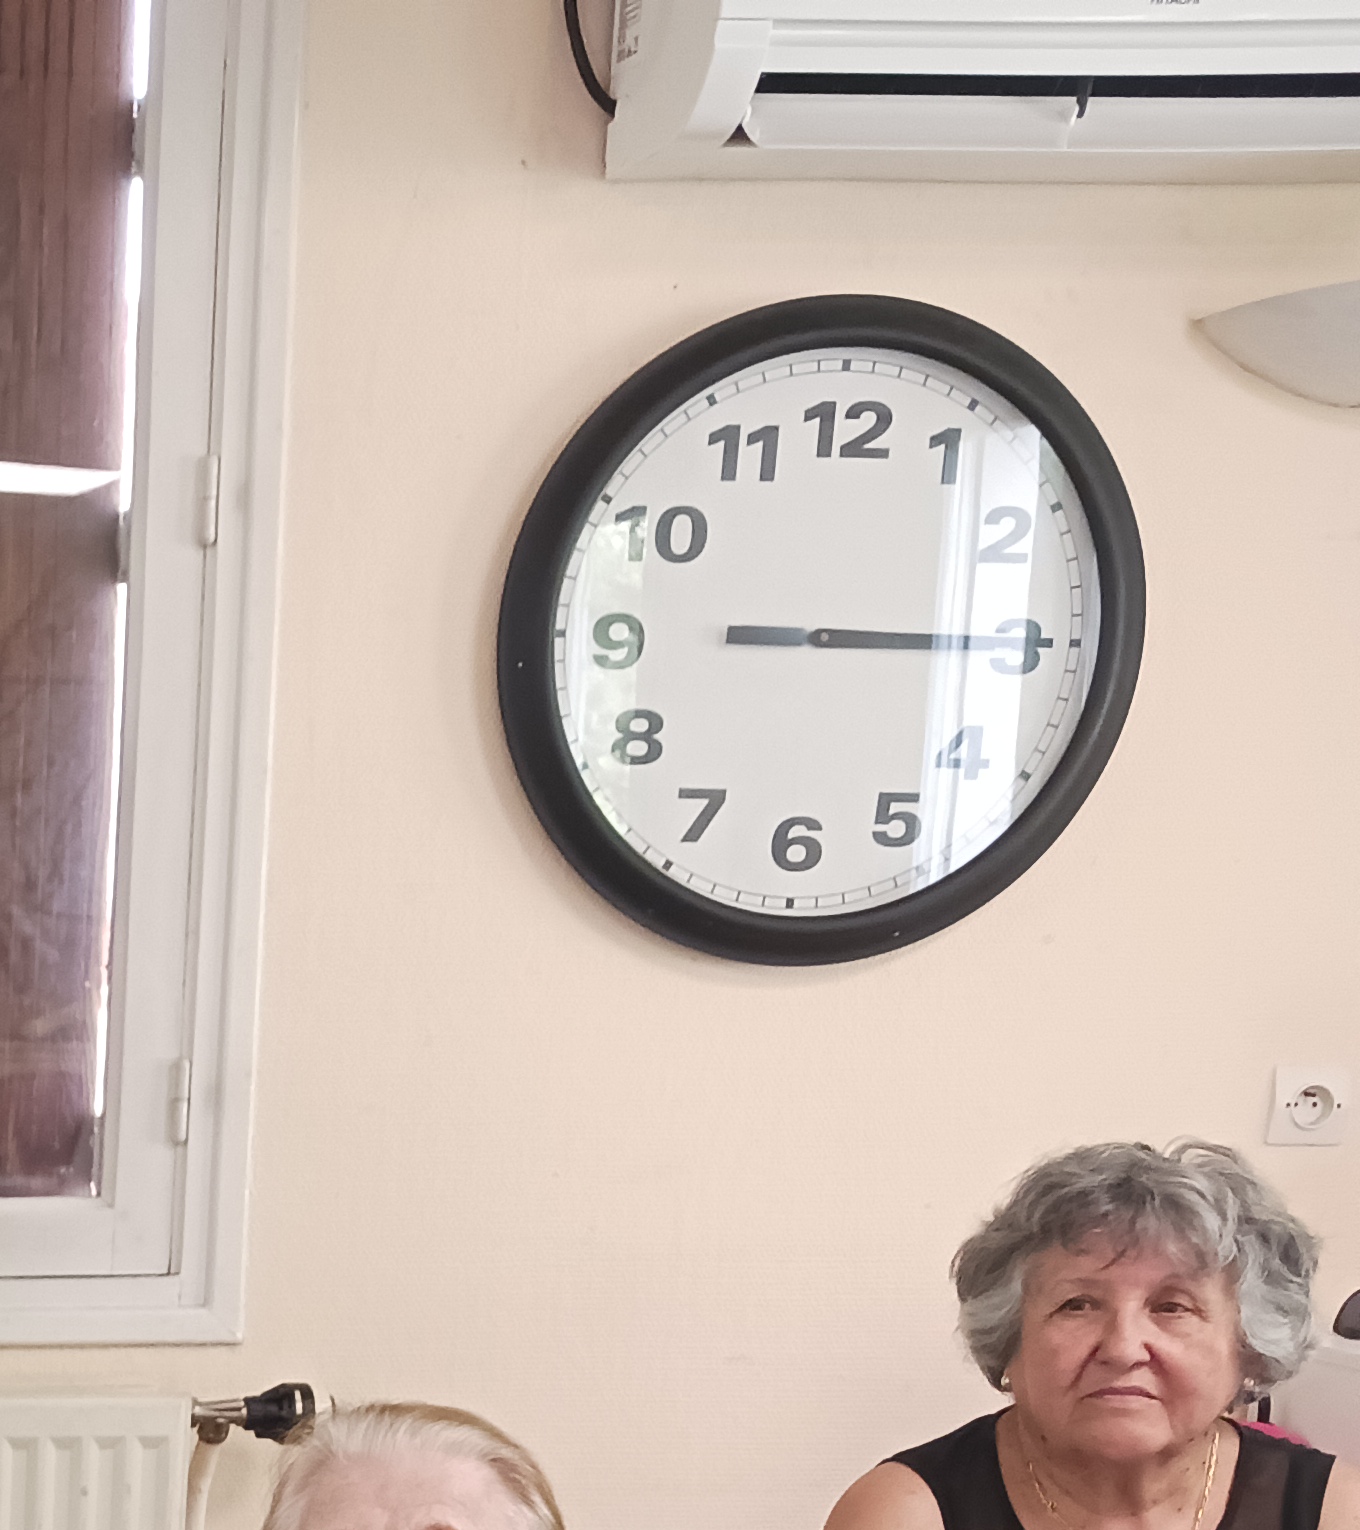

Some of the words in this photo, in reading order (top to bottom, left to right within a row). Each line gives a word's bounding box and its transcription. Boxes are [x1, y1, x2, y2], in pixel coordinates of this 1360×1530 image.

[707, 424, 780, 482] 11
[802, 400, 894, 460] 12
[928, 427, 962, 486] 1
[613, 504, 708, 564] 10
[977, 505, 1032, 564] 2
[591, 612, 645, 670] 9
[988, 617, 1042, 675] 3
[610, 708, 664, 766] 8
[933, 724, 990, 781] 4
[677, 786, 728, 844] 7
[770, 815, 824, 872] 6
[870, 791, 922, 848] 5
